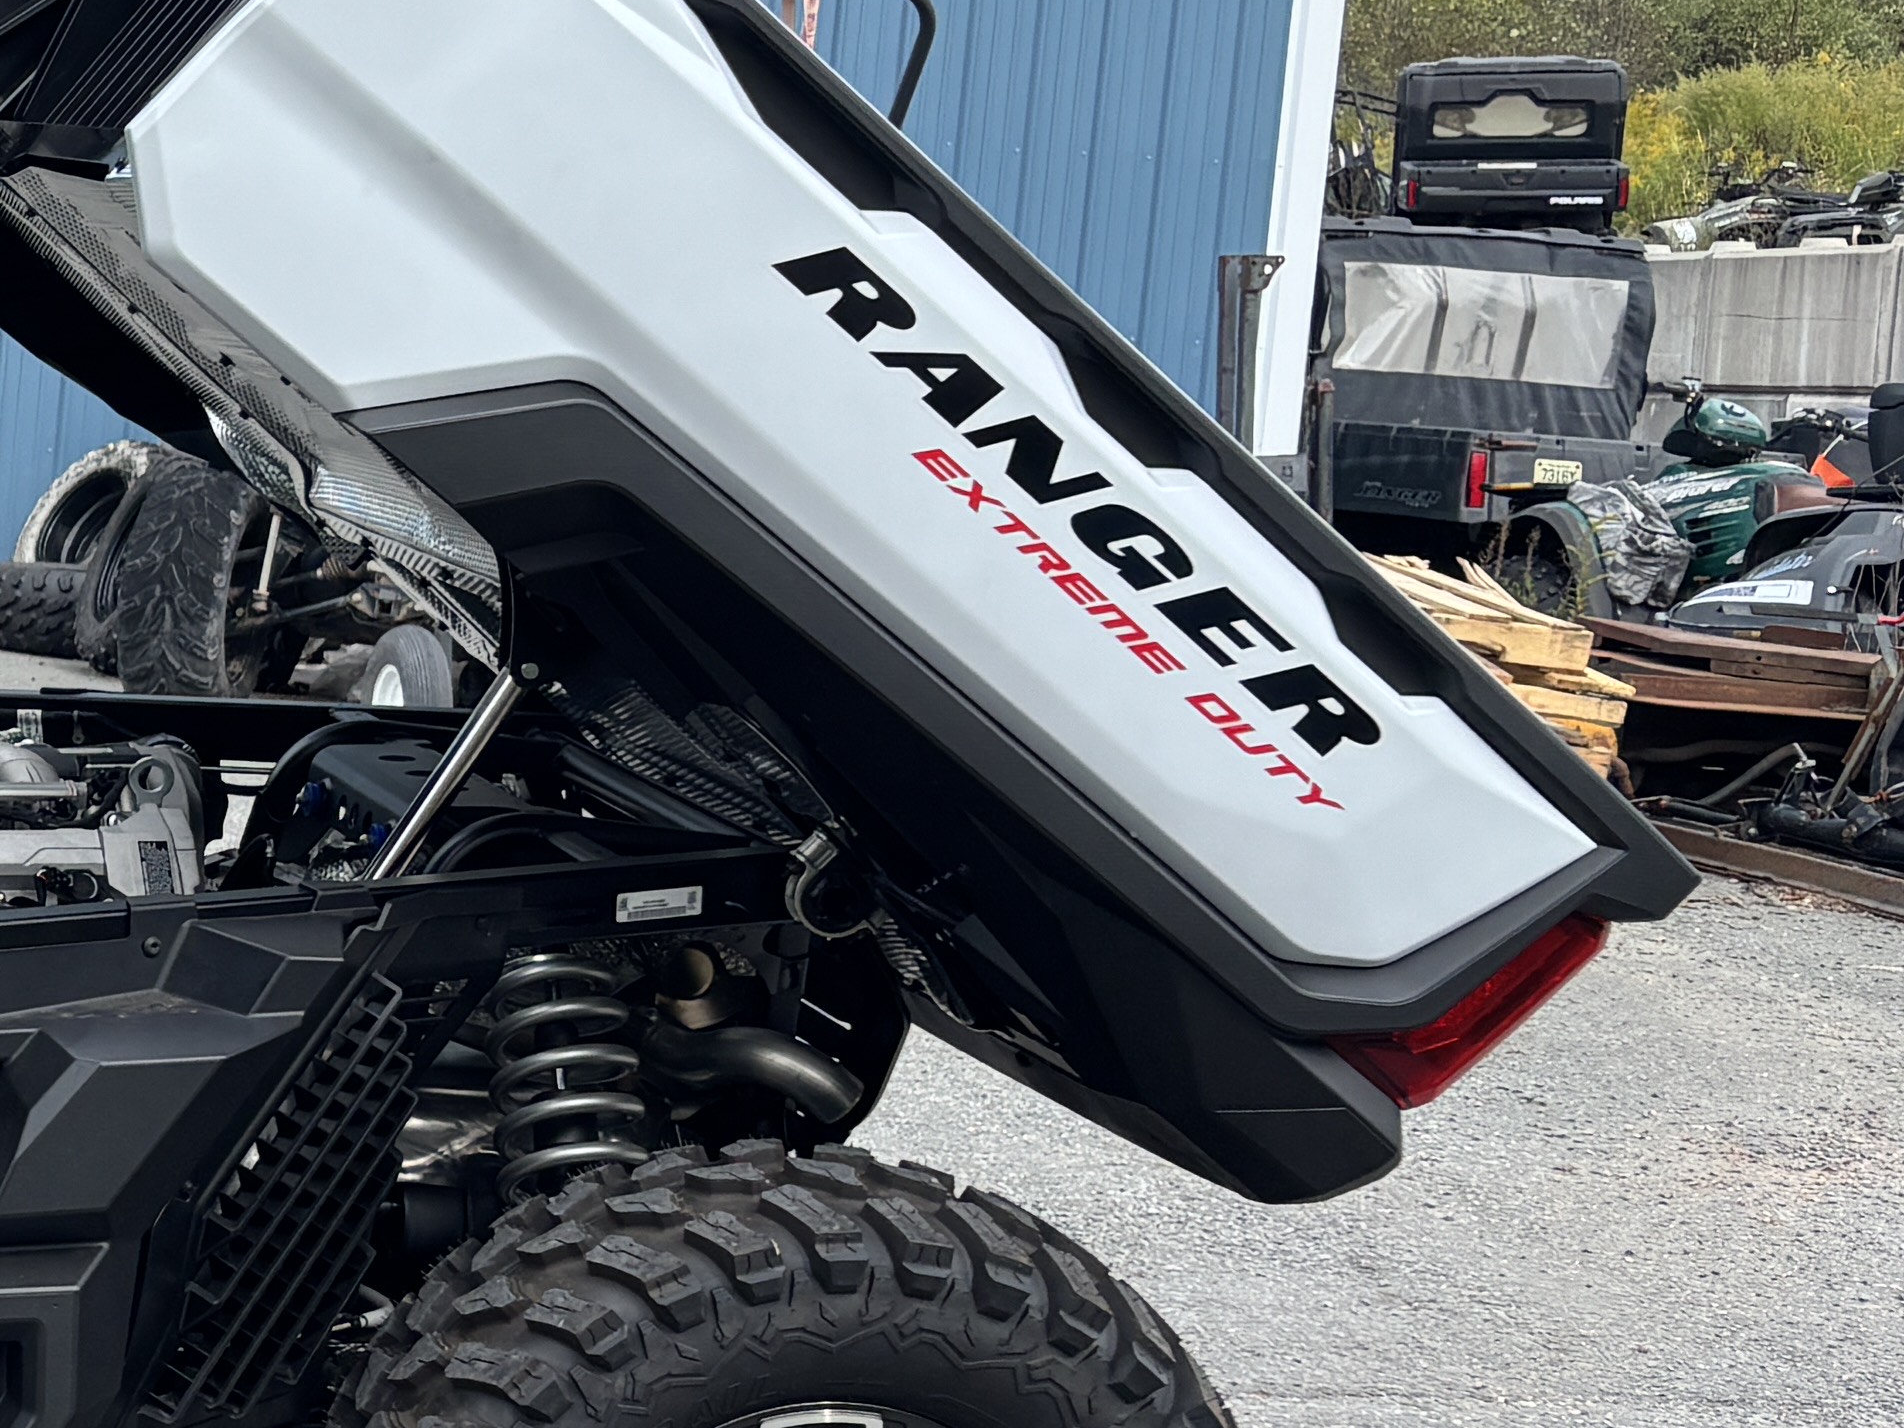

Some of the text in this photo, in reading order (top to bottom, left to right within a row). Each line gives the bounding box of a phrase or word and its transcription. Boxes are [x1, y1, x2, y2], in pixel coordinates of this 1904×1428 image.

[770, 245, 1382, 757] RANGER
[911, 448, 1346, 811] EXTREME DUTY
